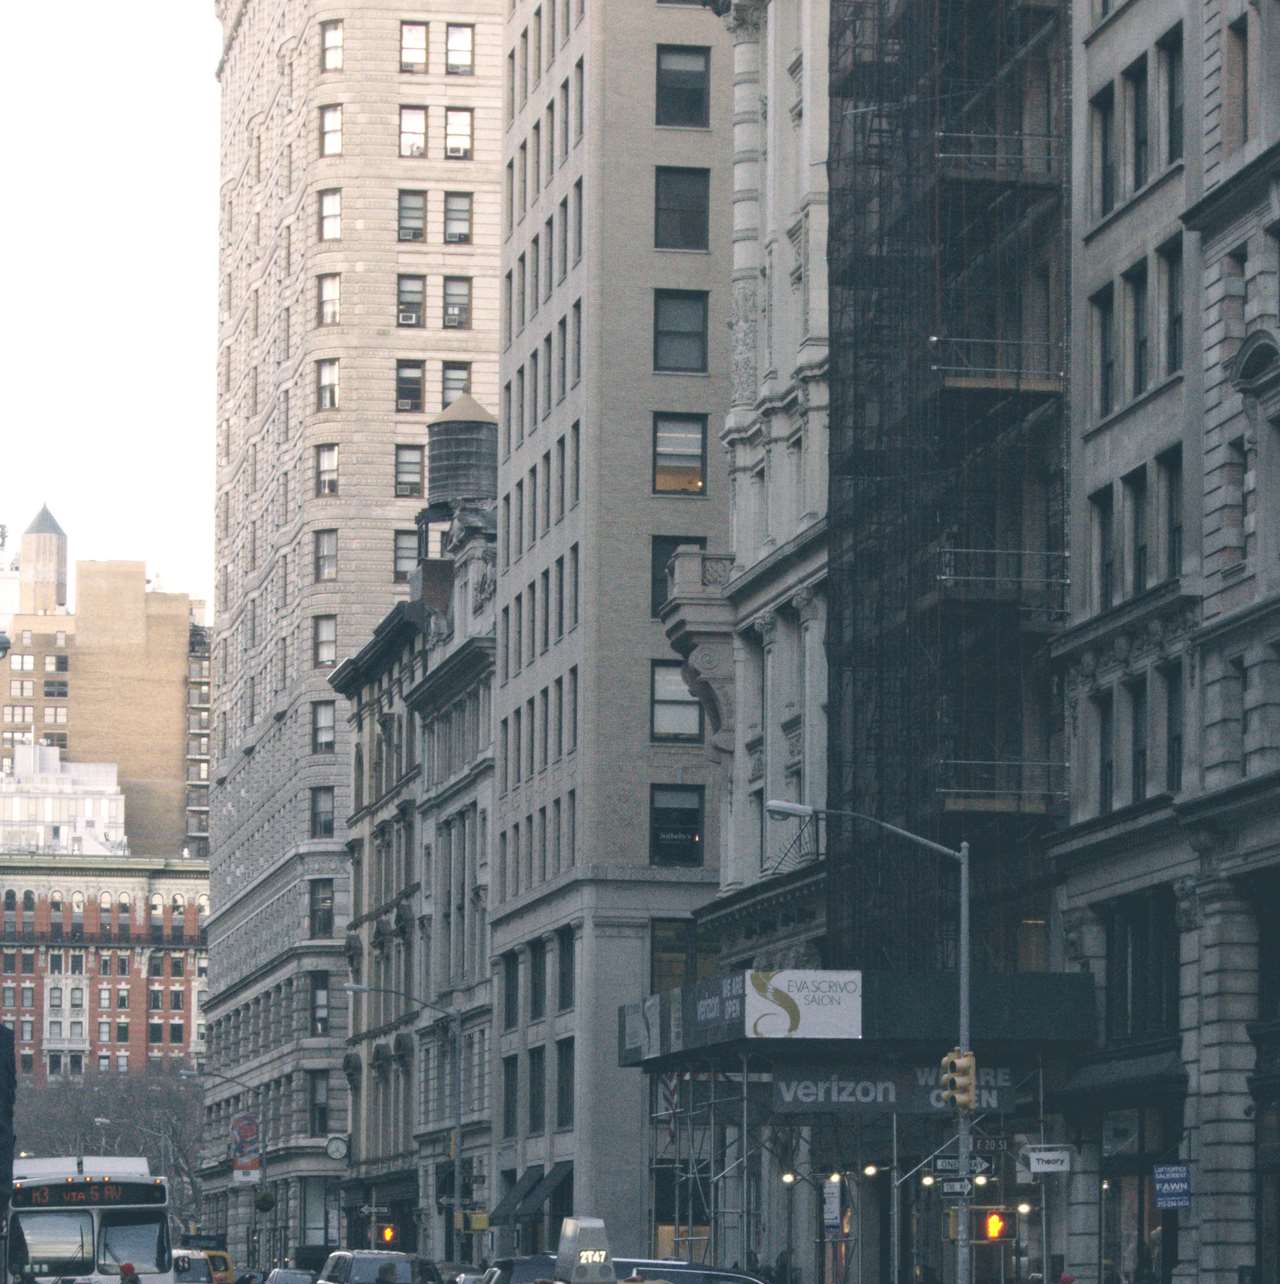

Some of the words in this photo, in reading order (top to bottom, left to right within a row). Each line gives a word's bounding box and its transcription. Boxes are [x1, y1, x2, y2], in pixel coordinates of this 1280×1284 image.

[803, 994, 841, 1006] SALON
[978, 1067, 1011, 1087] RE
[778, 1074, 895, 1103] verizon
[985, 1139, 995, 1150] 20
[1035, 1157, 1065, 1167] Theory
[580, 1250, 606, 1264] 2T47
